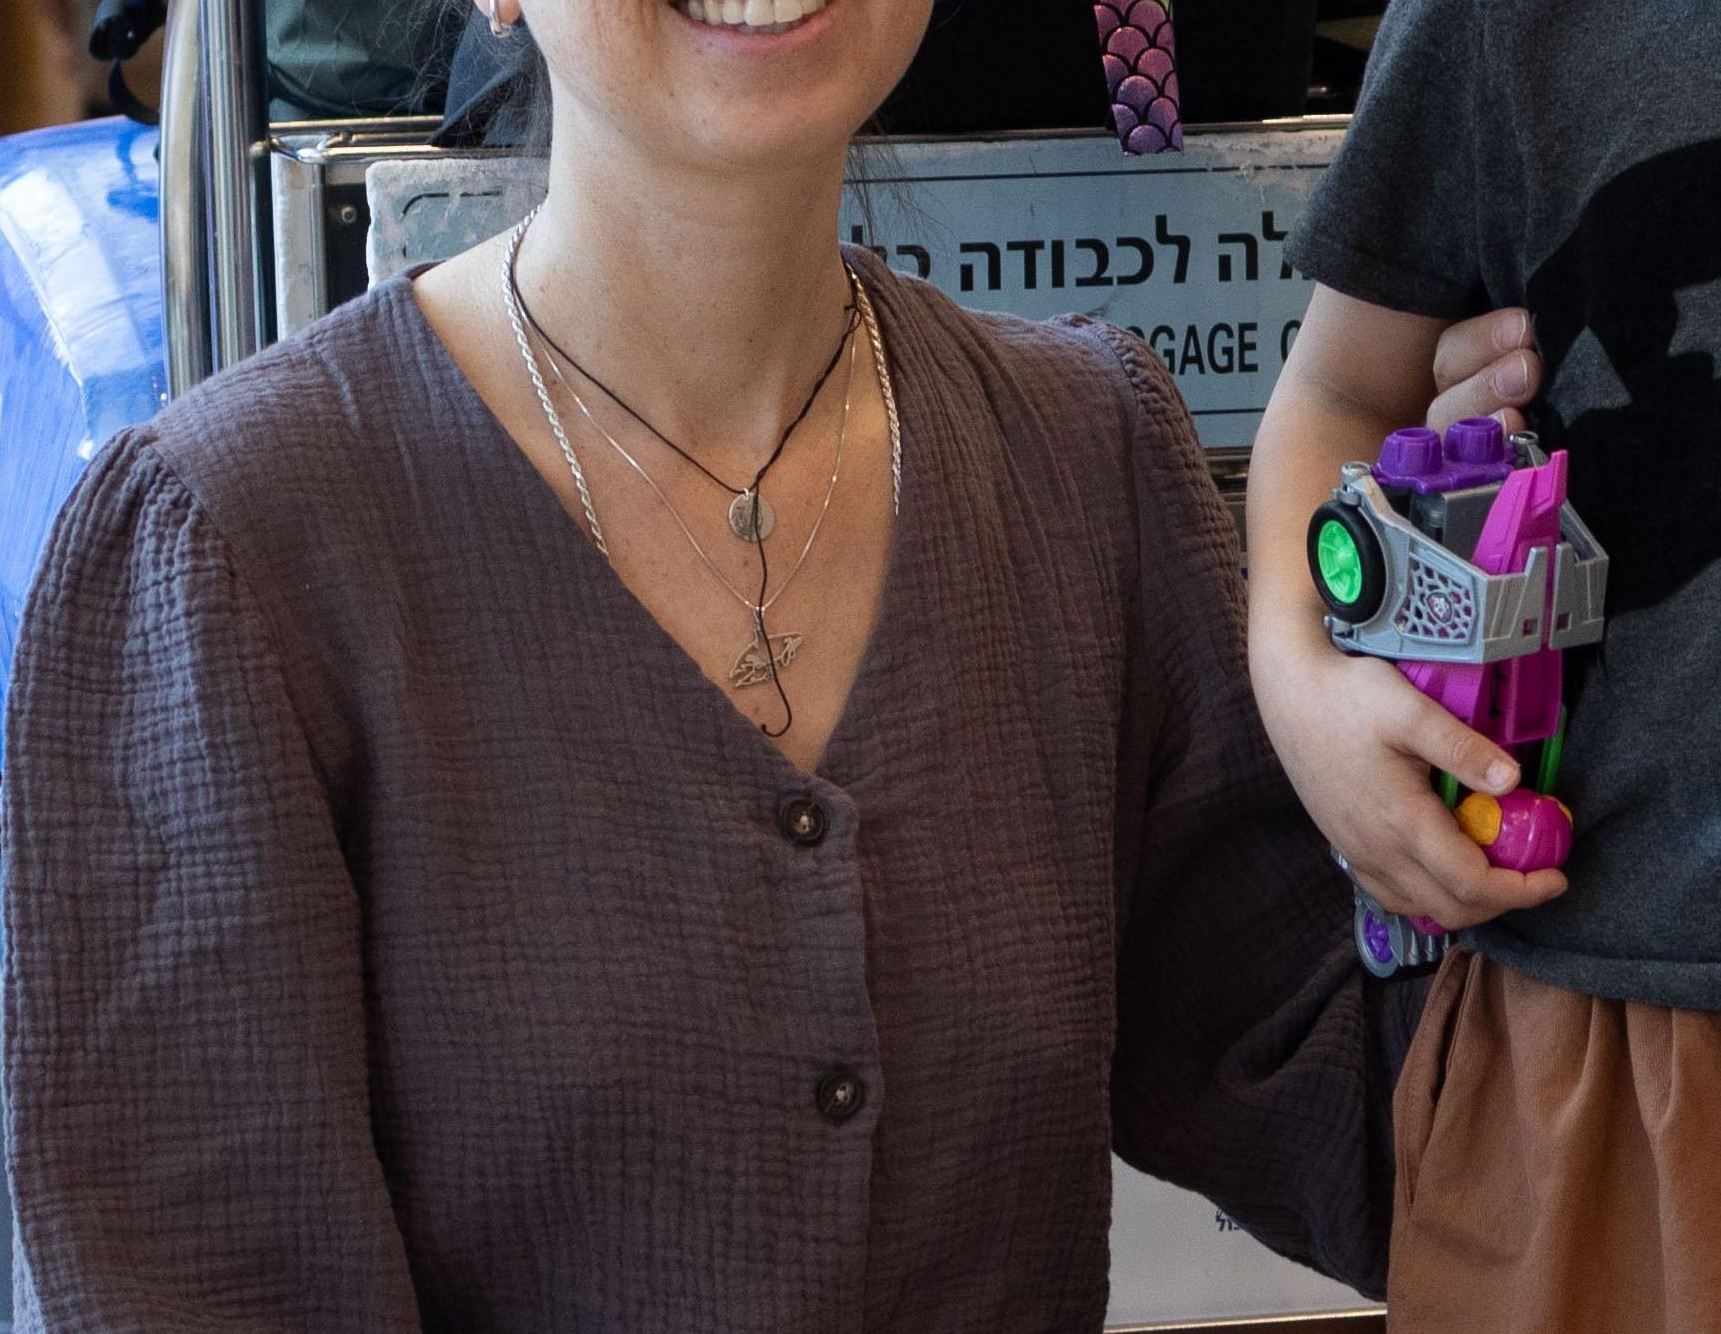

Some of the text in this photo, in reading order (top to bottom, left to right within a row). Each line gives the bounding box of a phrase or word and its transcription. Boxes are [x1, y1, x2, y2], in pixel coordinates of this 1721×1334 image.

[959, 214, 1191, 291] לכבודה
[1217, 210, 1312, 282] לה
[1127, 321, 1259, 375] GAGE
